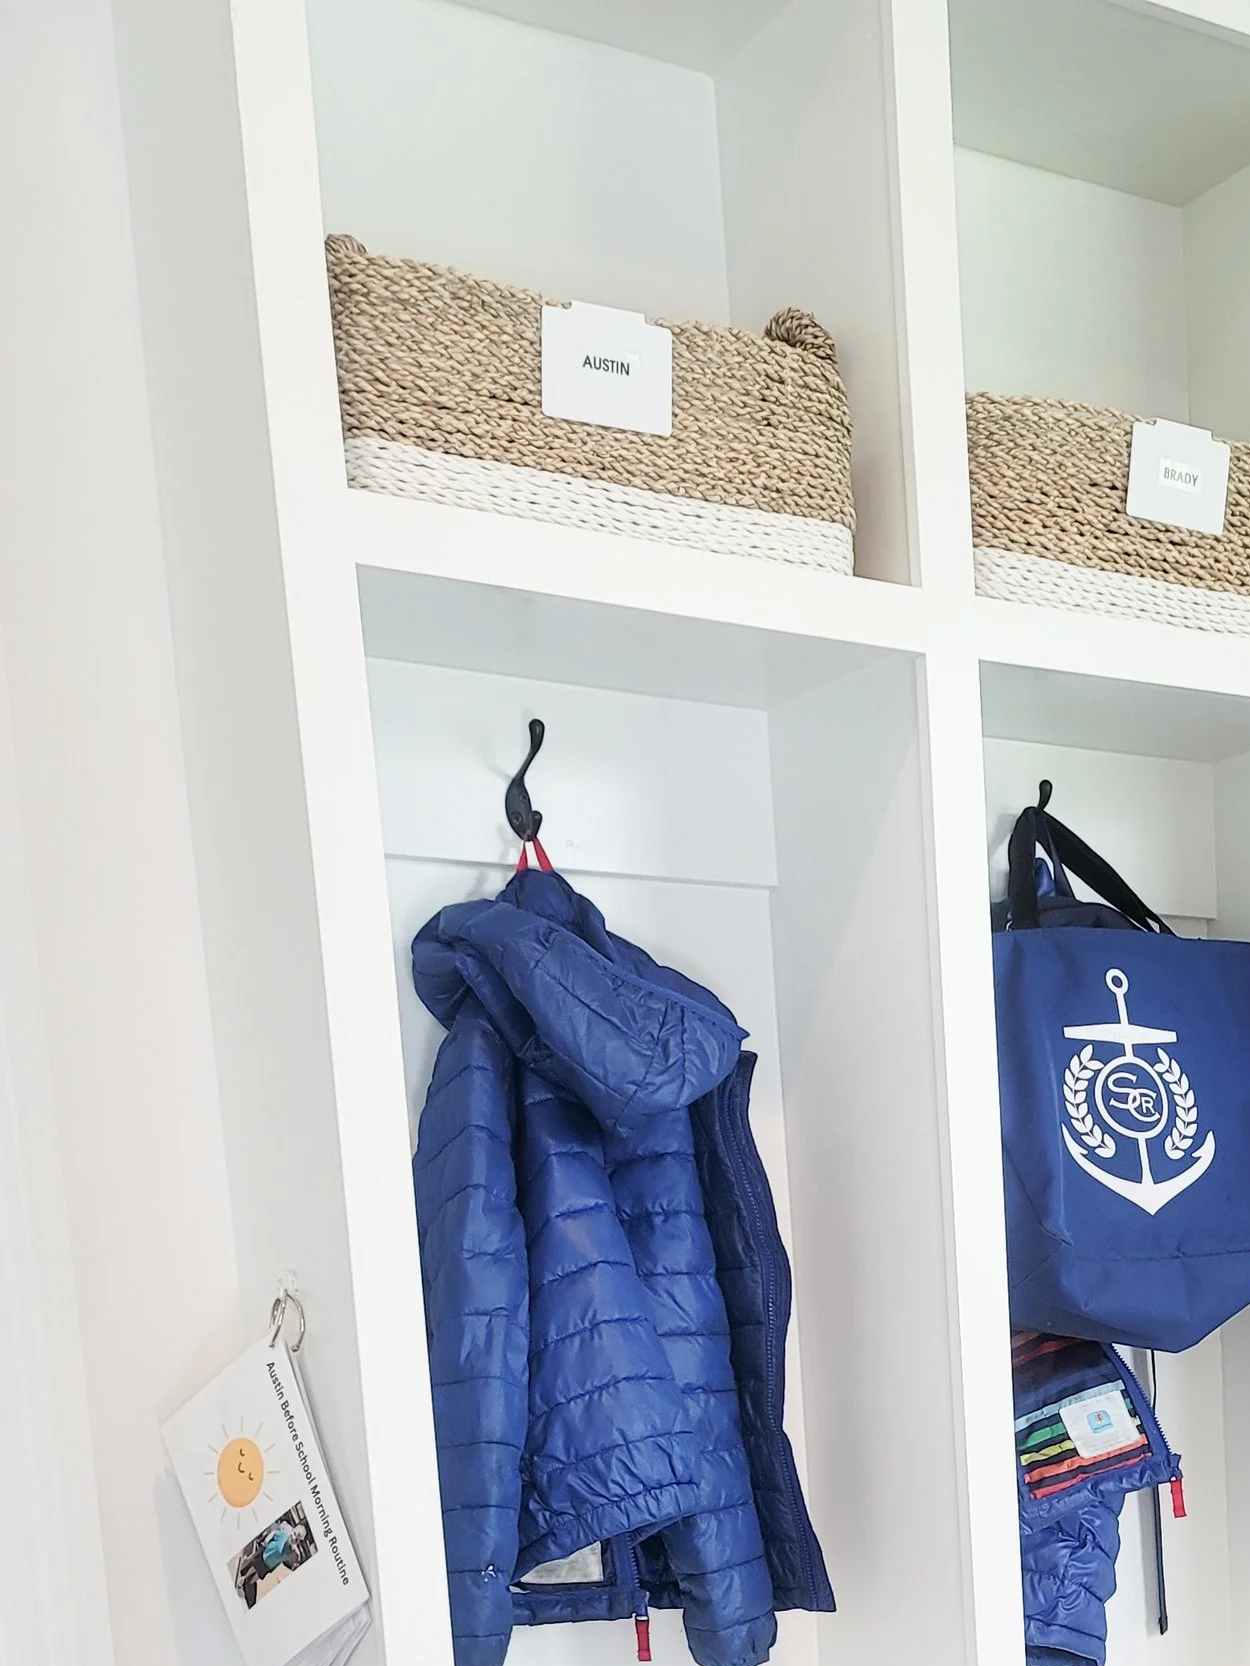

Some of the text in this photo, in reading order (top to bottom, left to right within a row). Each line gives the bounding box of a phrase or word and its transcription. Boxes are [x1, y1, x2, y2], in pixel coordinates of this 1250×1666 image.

[582, 354, 631, 377] AUSTIN
[1163, 466, 1199, 488] BRADY
[266, 1362, 350, 1586] Austin Before School Morning Routine
